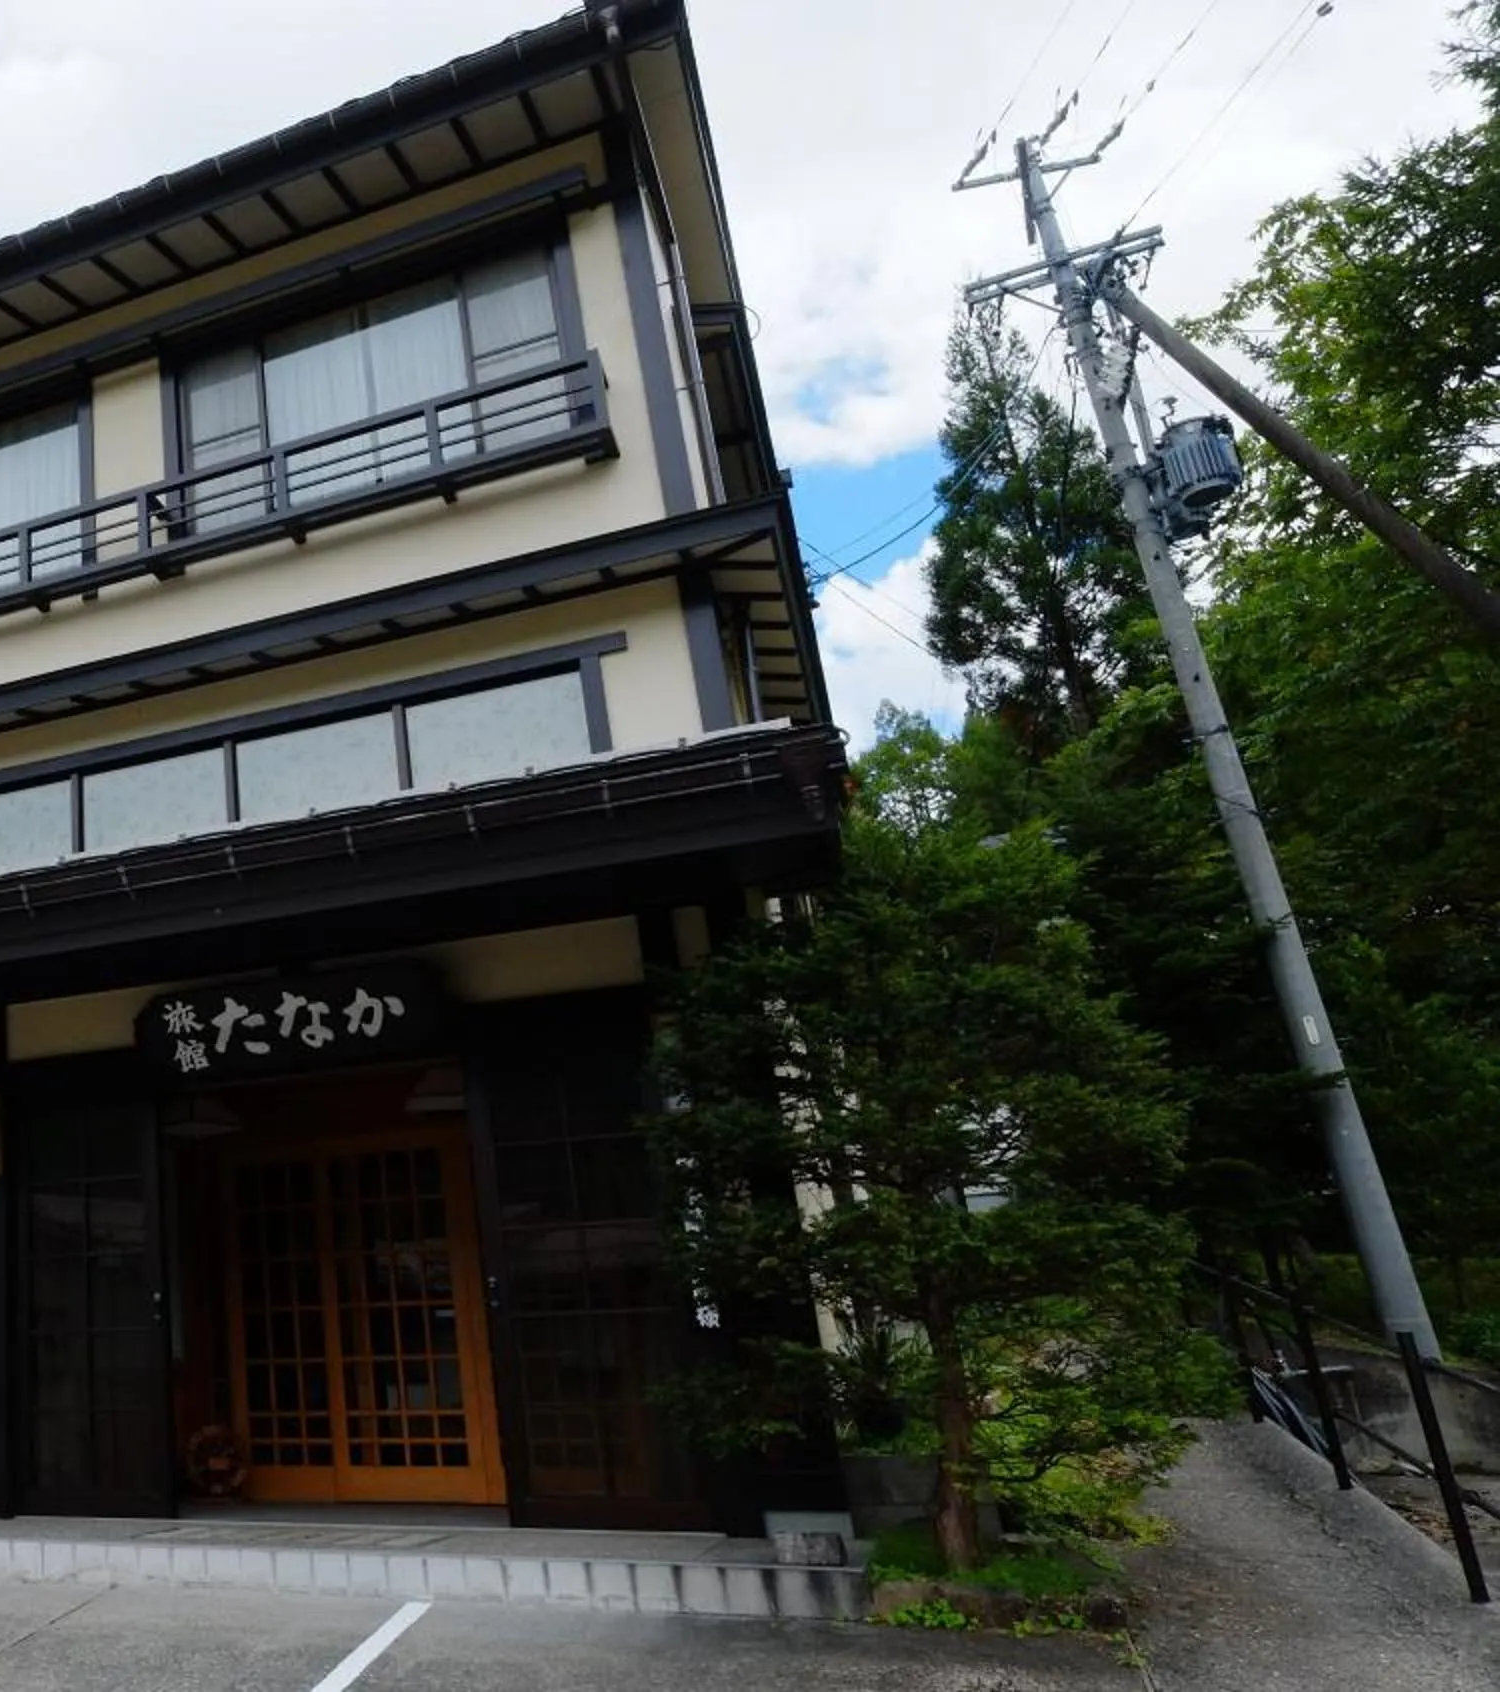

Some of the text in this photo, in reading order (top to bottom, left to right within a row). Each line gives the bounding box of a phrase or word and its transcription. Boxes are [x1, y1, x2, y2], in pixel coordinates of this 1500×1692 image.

[162, 1000, 210, 1073] 旅館
[211, 987, 405, 1054] たなか
